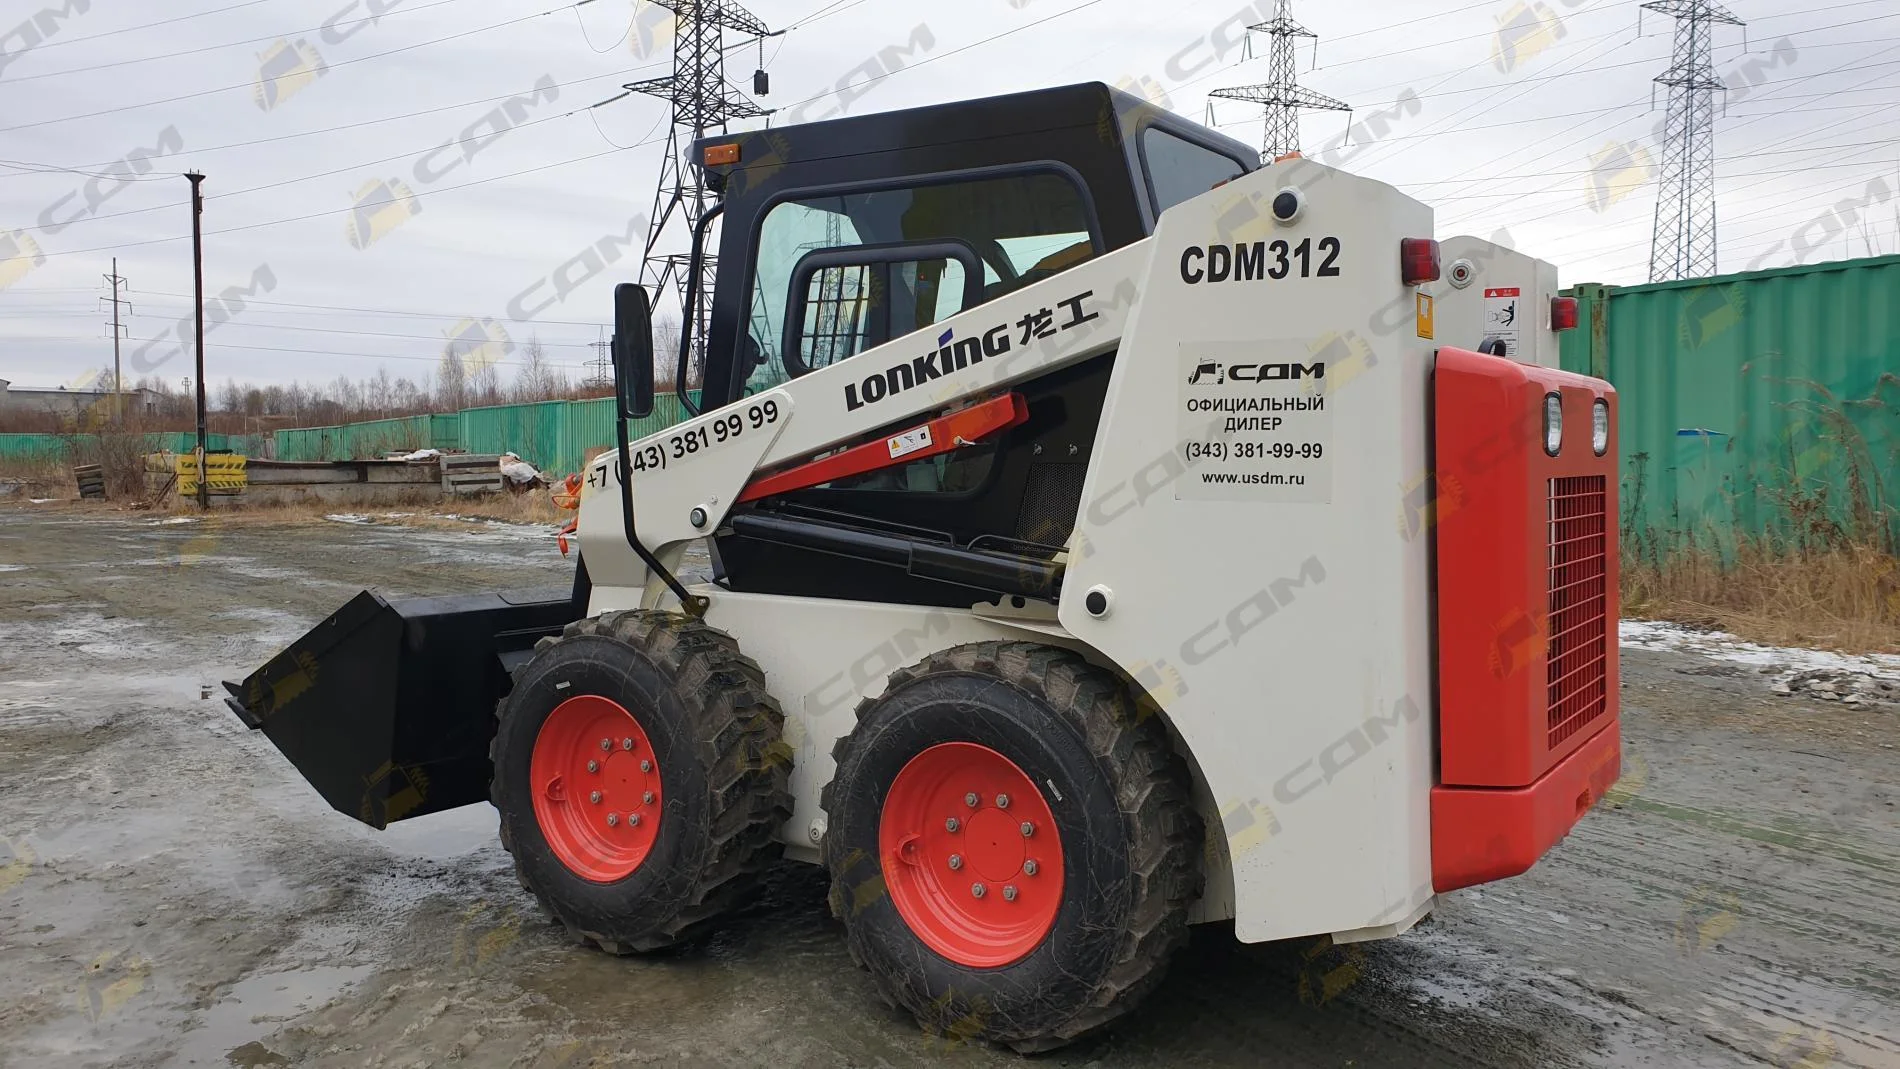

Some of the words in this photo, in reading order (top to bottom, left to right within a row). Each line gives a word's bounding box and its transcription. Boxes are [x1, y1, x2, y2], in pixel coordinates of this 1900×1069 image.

[1180, 236, 1341, 284] CDM312
[1016, 290, 1099, 345] 龙工
[1187, 394, 1324, 413] ОФИЦИАЛЬНЫЙ
[1224, 417, 1282, 433] ДИЛЕР
[587, 465, 607, 488] +7
[614, 444, 667, 487] (43)
[671, 426, 709, 459] 381
[713, 414, 743, 442] 99
[749, 400, 779, 429] 99
[1186, 442, 1228, 461] (343)
[1234, 443, 1323, 458] 381-99-99
[1202, 472, 1305, 485] www.usdm.ru
